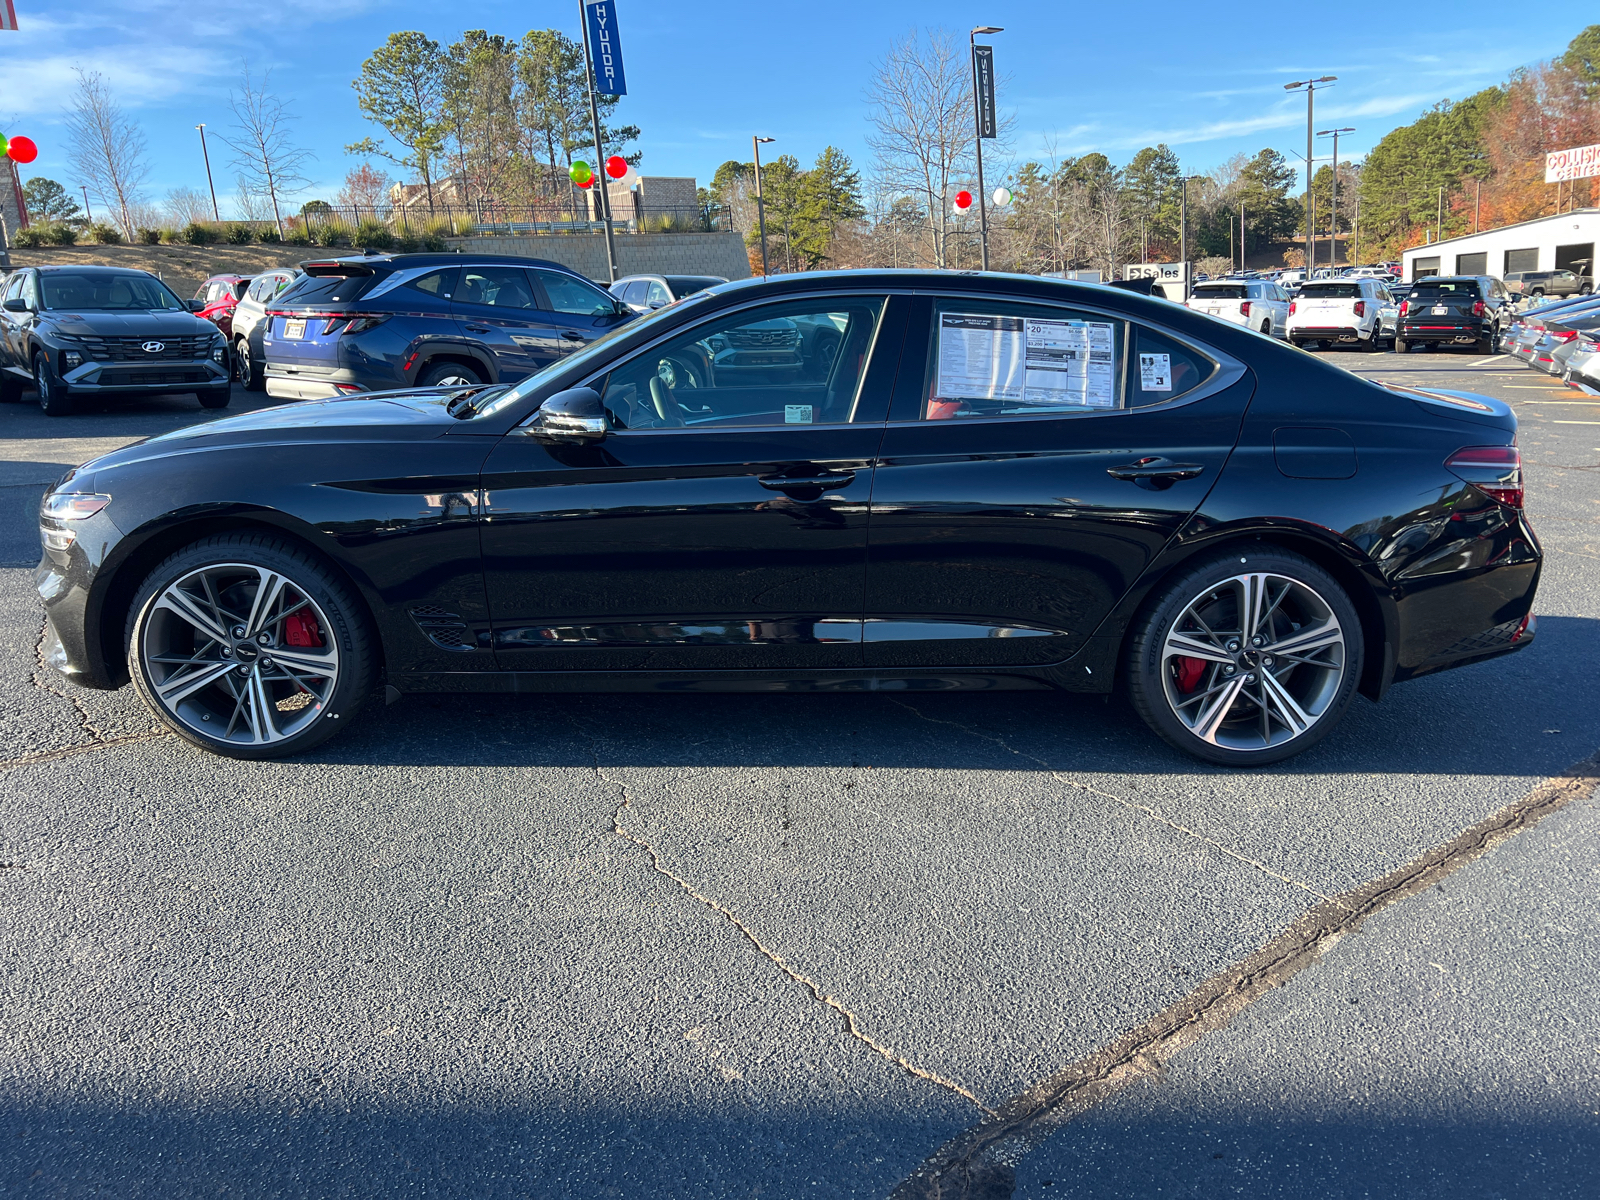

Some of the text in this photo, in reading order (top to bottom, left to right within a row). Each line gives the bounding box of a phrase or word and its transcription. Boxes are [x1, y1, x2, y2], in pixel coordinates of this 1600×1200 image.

[596, 5, 614, 90] HYUNDAI
[981, 59, 990, 134] GENESIS
[1143, 268, 1179, 279] Sales
[1031, 325, 1041, 333] 20
[328, 603, 352, 651] MICHELIN
[1149, 619, 1167, 665] MICHELIN
